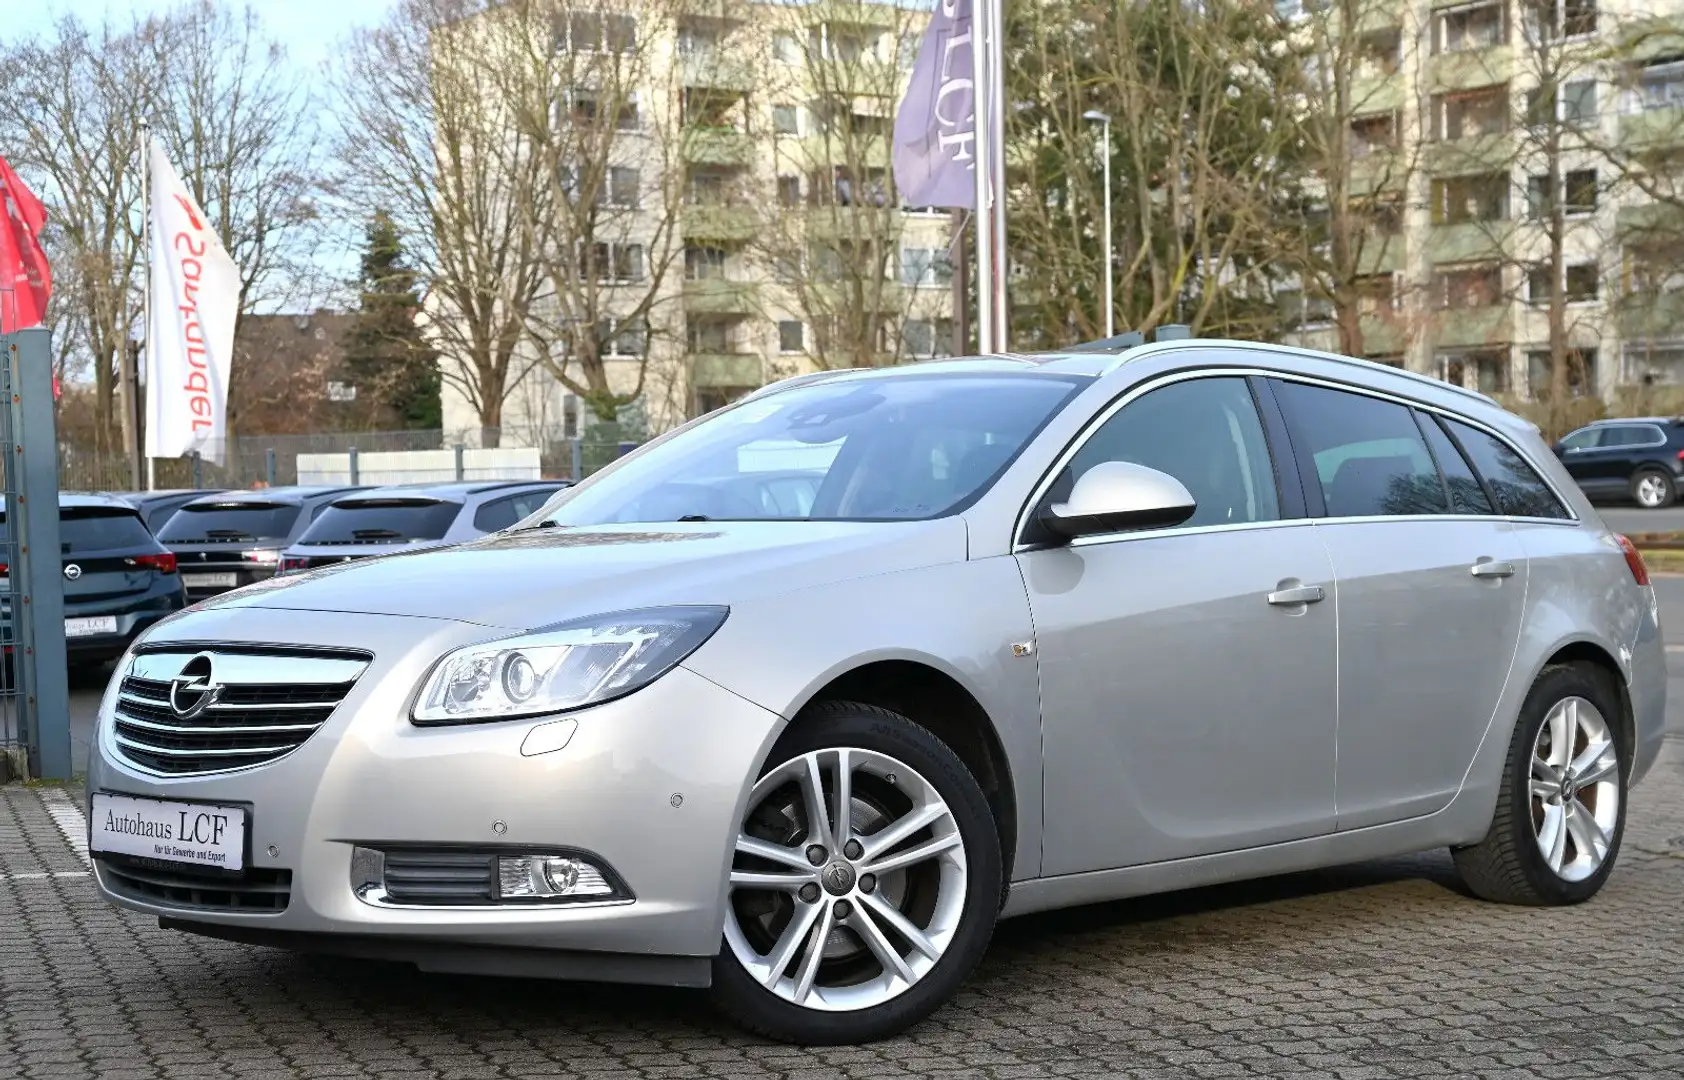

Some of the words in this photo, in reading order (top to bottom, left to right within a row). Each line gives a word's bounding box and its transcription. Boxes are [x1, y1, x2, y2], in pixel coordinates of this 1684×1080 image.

[104, 809, 172, 839] Autohaus
[177, 811, 228, 845] LCF
[154, 844, 163, 854] Nur
[172, 846, 195, 859] Gewerbe
[197, 850, 207, 860] und
[207, 850, 226, 863] Export
